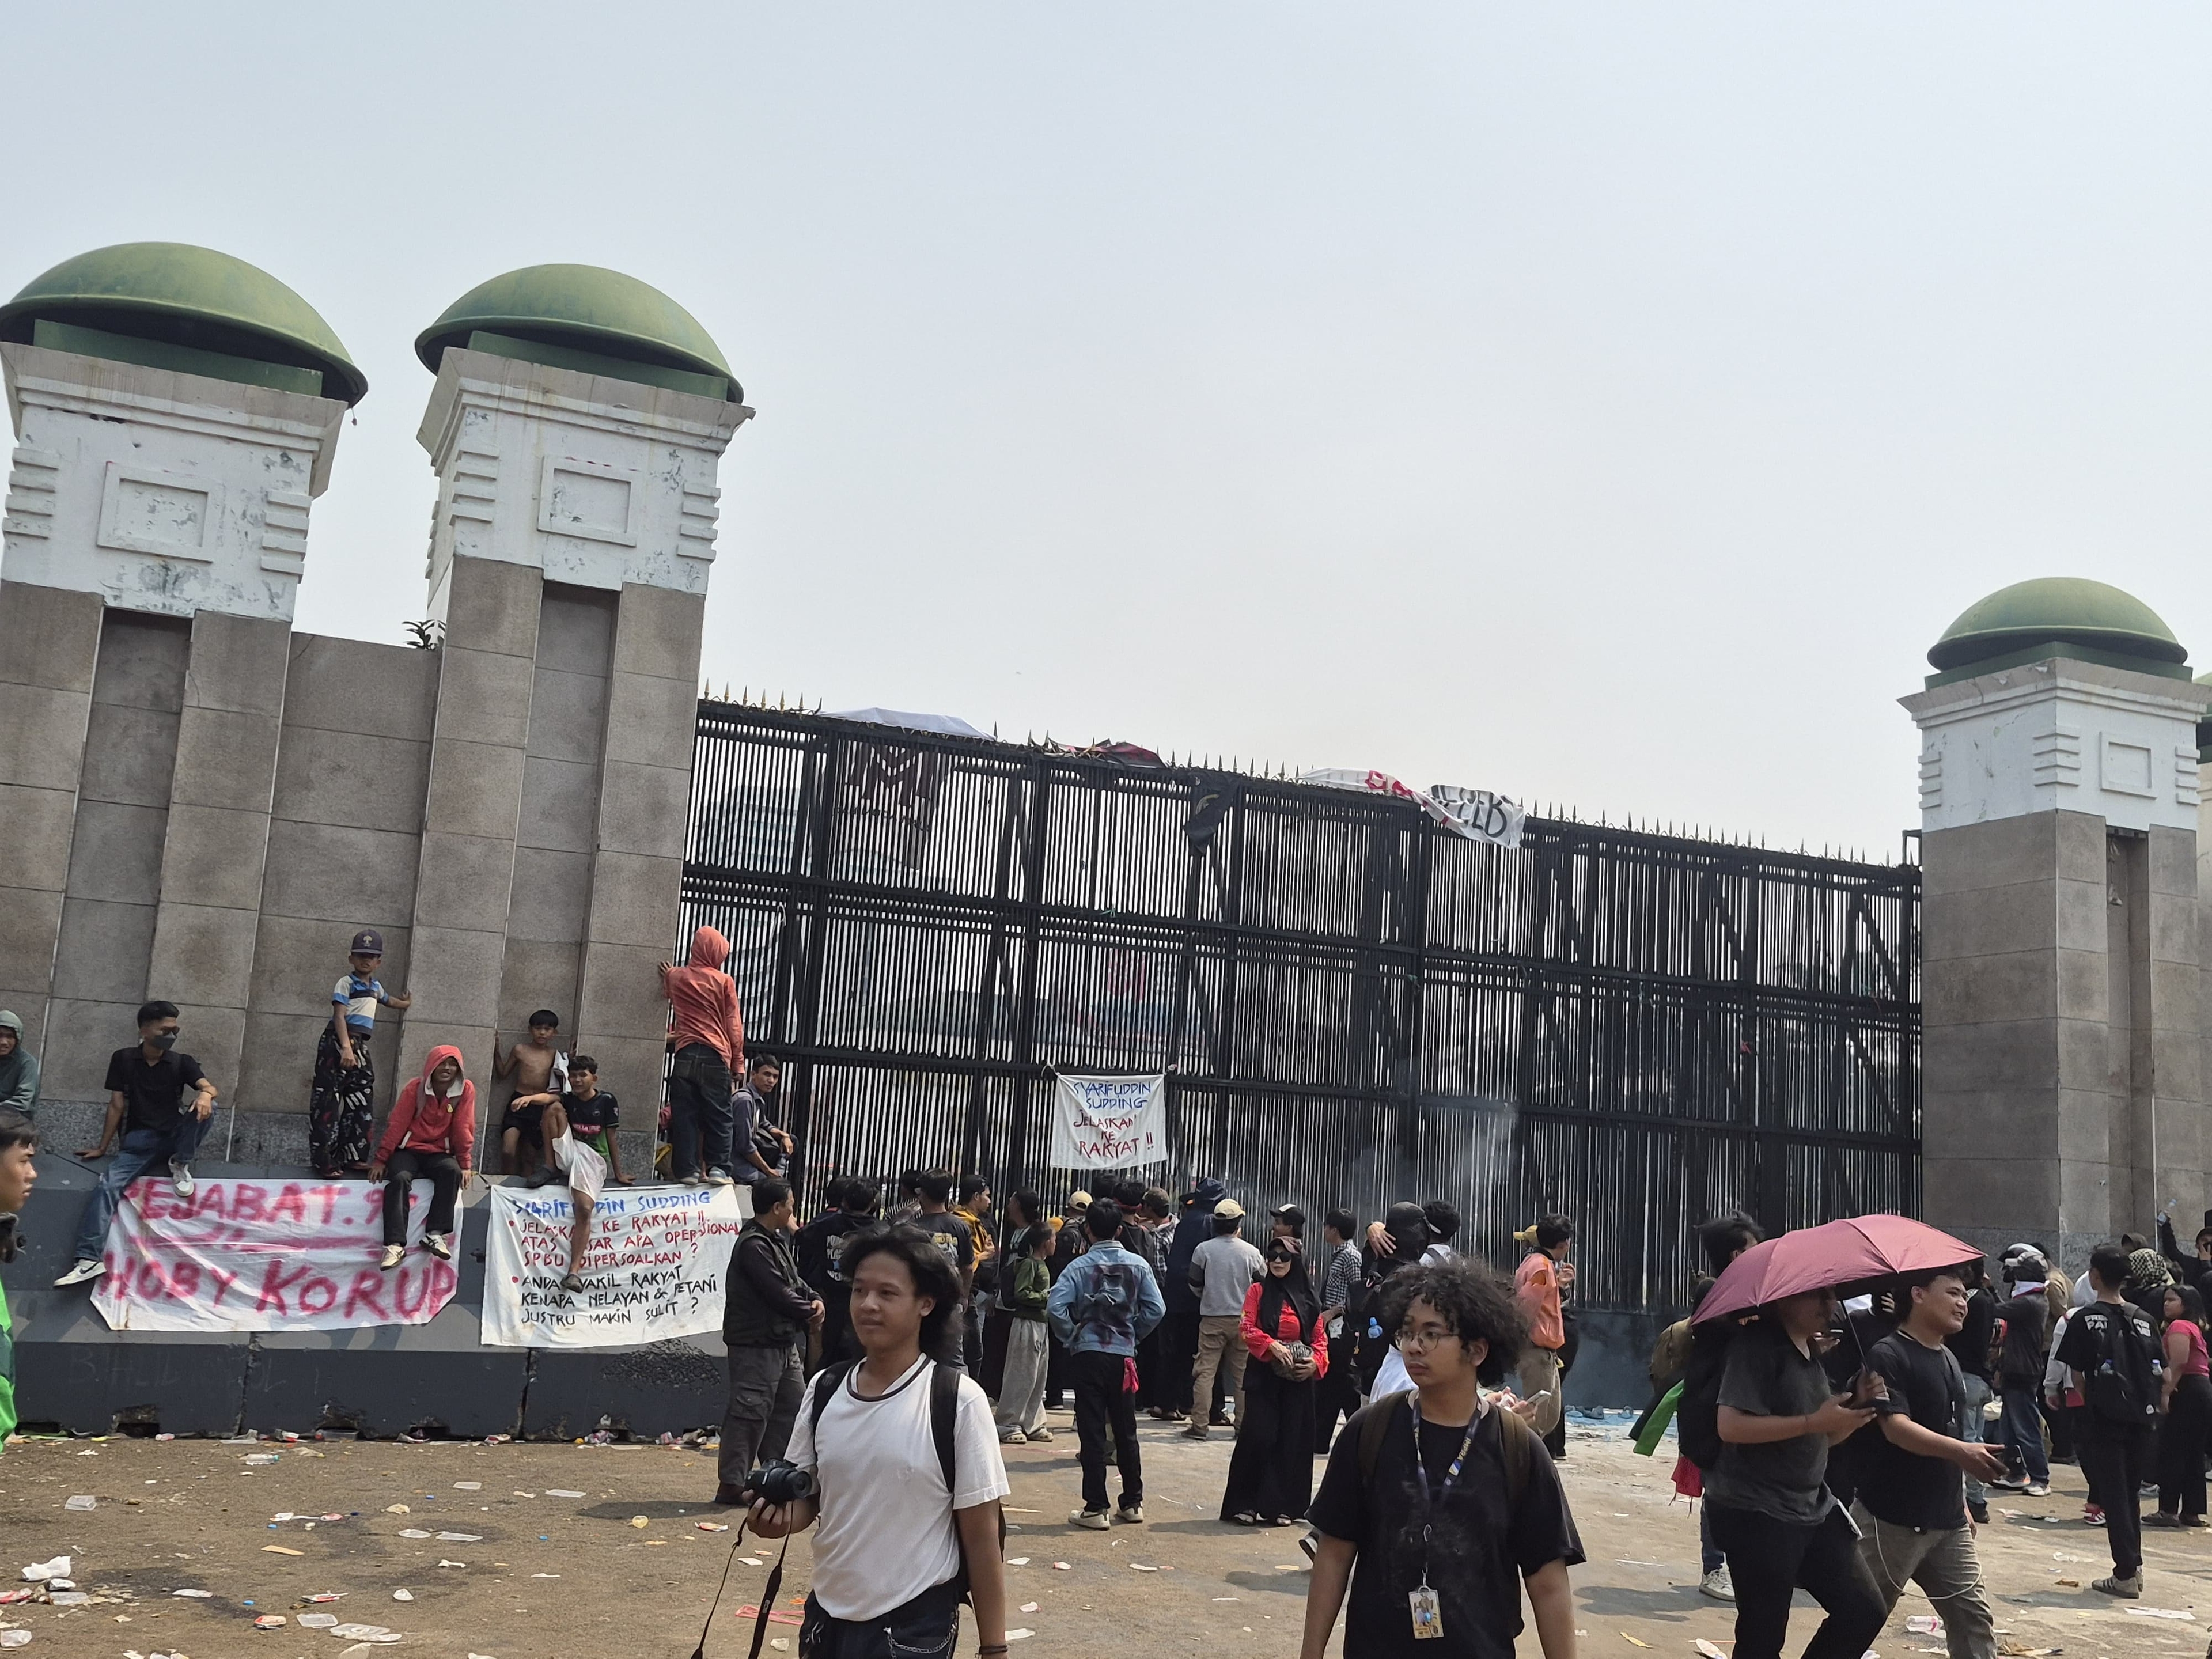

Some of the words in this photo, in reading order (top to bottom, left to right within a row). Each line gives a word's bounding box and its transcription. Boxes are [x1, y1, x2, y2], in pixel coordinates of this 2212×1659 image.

[1073, 1081, 1151, 1097] SYARIFUDDIN
[1086, 1096, 1148, 1109] SUDDING
[1079, 1138, 1139, 1159] RAKYAT
[1146, 1131, 1154, 1150] !!
[1101, 1131, 1115, 1143] KE
[637, 1191, 711, 1211] SUDDING
[602, 1219, 620, 1233] KE
[632, 1211, 688, 1233] RAKYAT
[521, 1237, 557, 1252] ATAS
[624, 1235, 654, 1248] APA
[524, 1251, 565, 1267] SPBU
[521, 1275, 562, 1290] ANDA
[631, 1264, 683, 1289] RAKYAT
[255, 1256, 456, 1321] KORUP
[521, 1291, 576, 1309] KENAPA
[588, 1290, 649, 1308] NELAYAN
[654, 1287, 668, 1300] &
[674, 1273, 717, 1297] PETANI
[521, 1308, 576, 1327] JUSTRU
[589, 1308, 632, 1324] MAKIN
[645, 1299, 679, 1321] SULIT
